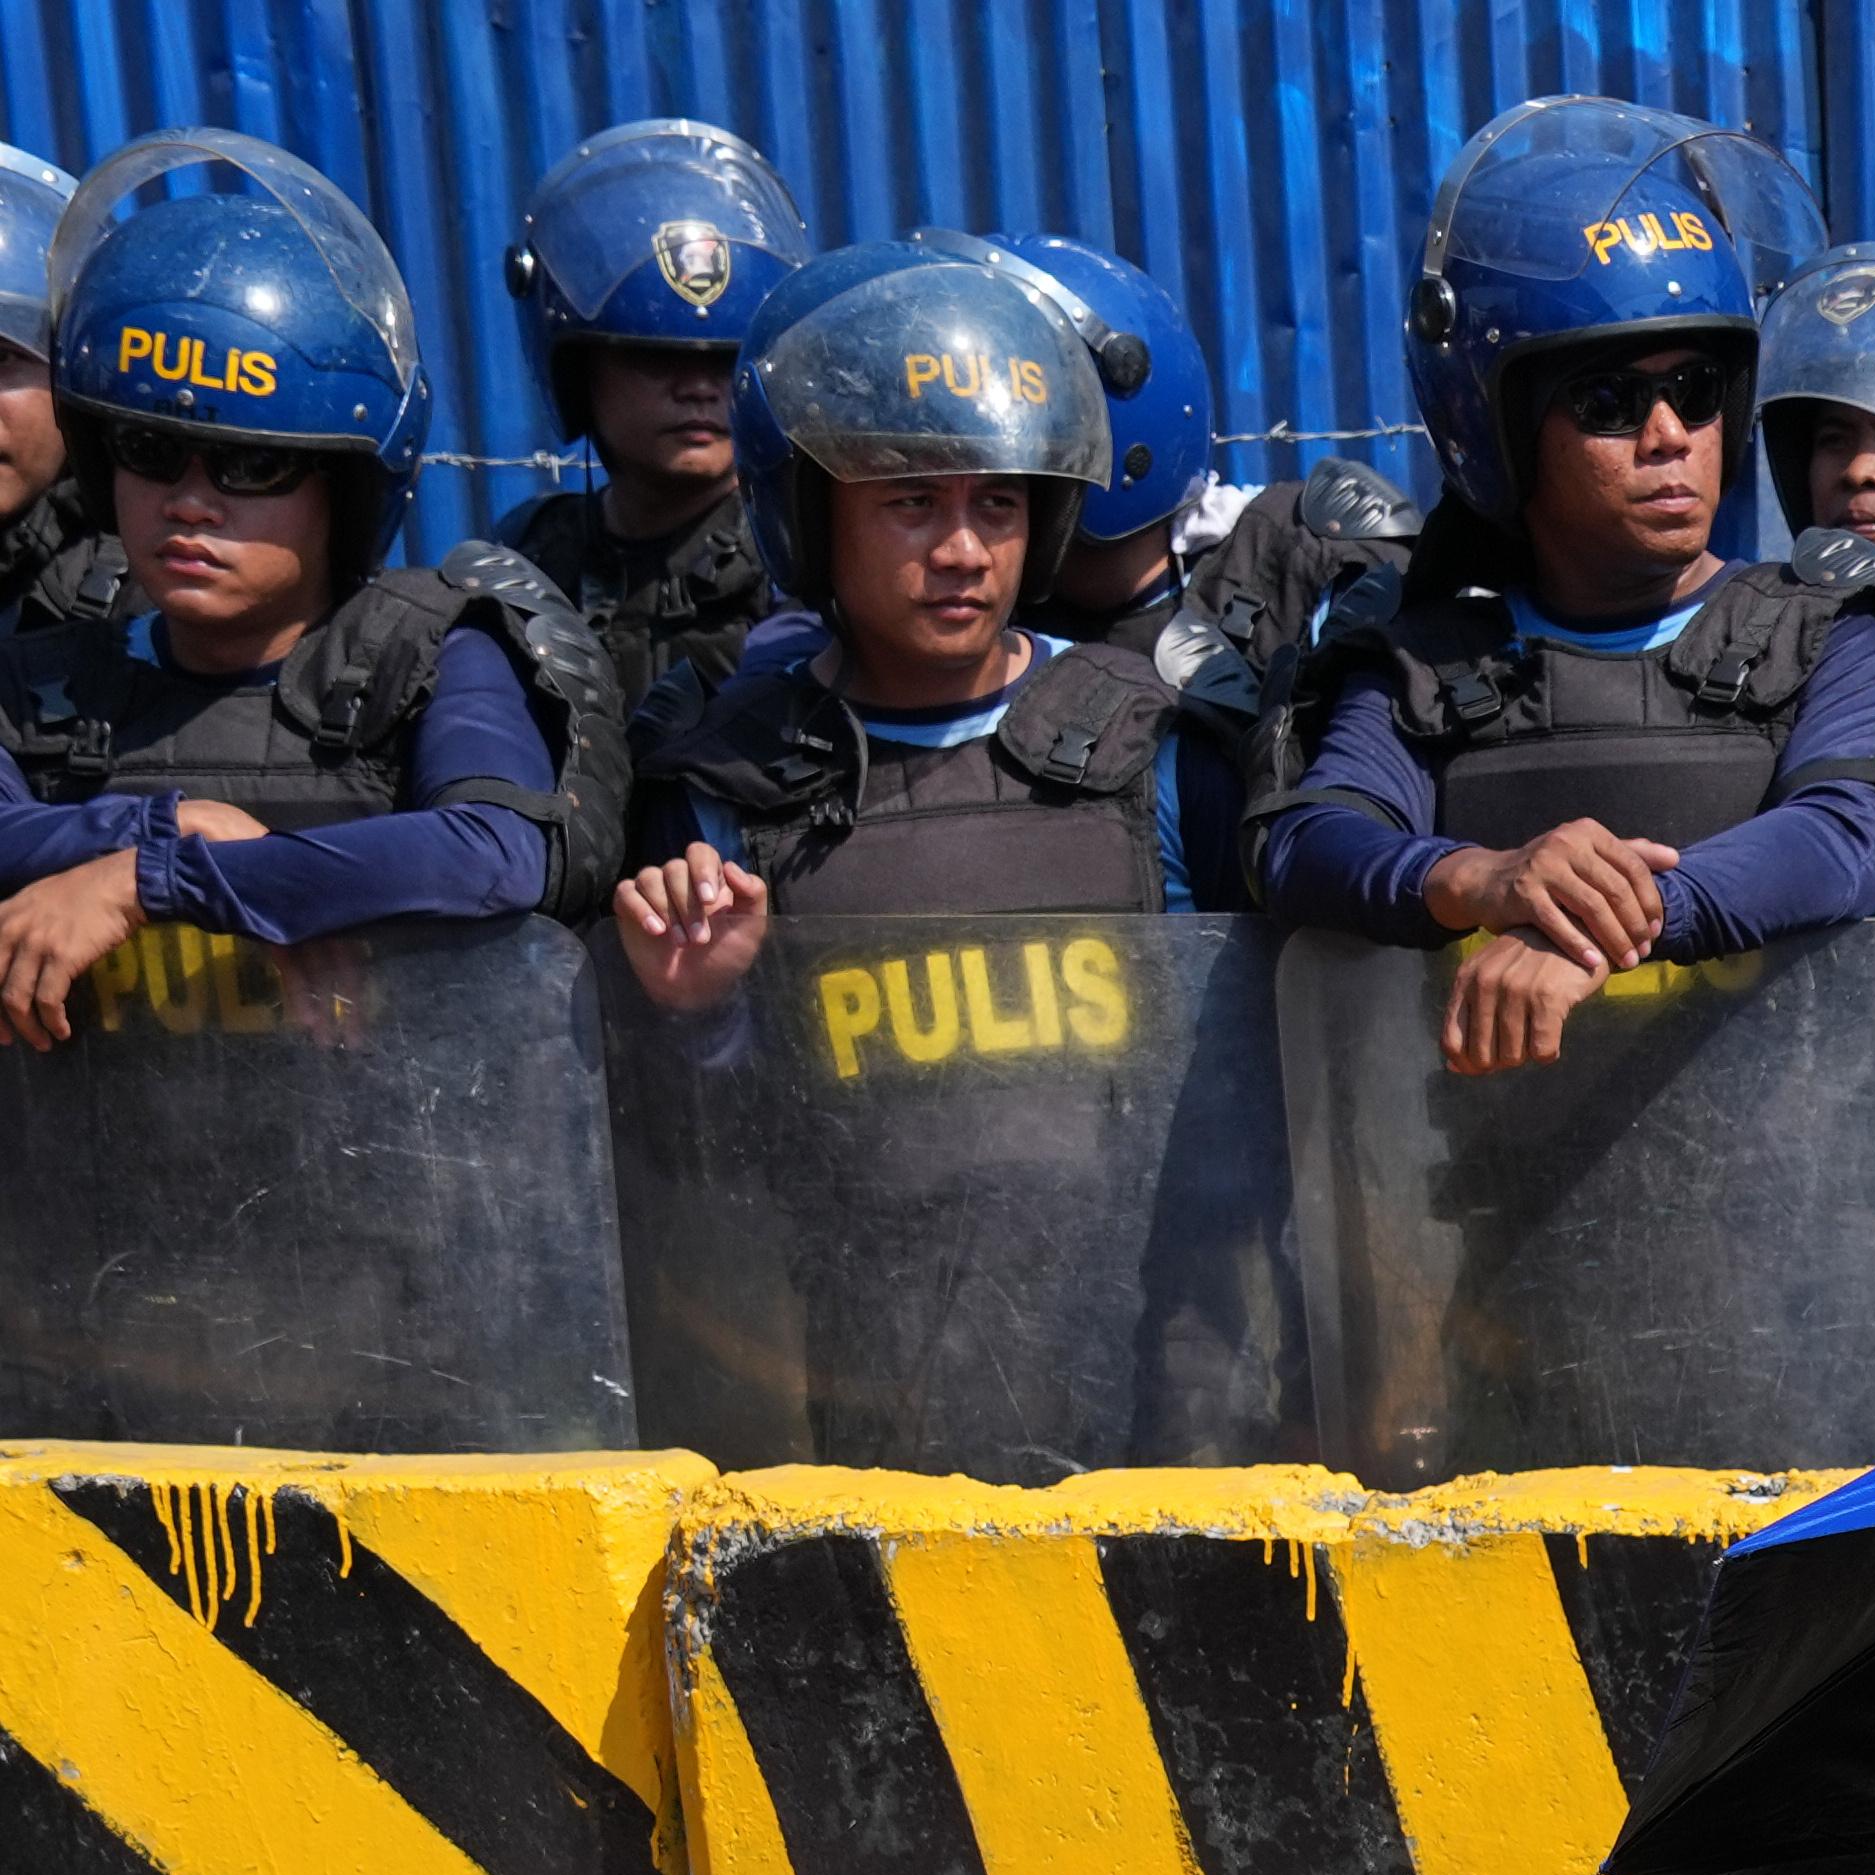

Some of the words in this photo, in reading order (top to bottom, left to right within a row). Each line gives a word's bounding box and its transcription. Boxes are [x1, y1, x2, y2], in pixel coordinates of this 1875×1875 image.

[1583, 211, 1713, 265] PULIS
[118, 326, 277, 397] PULIS
[905, 353, 1049, 405] PULIS
[819, 936, 1131, 1078] PULIS
